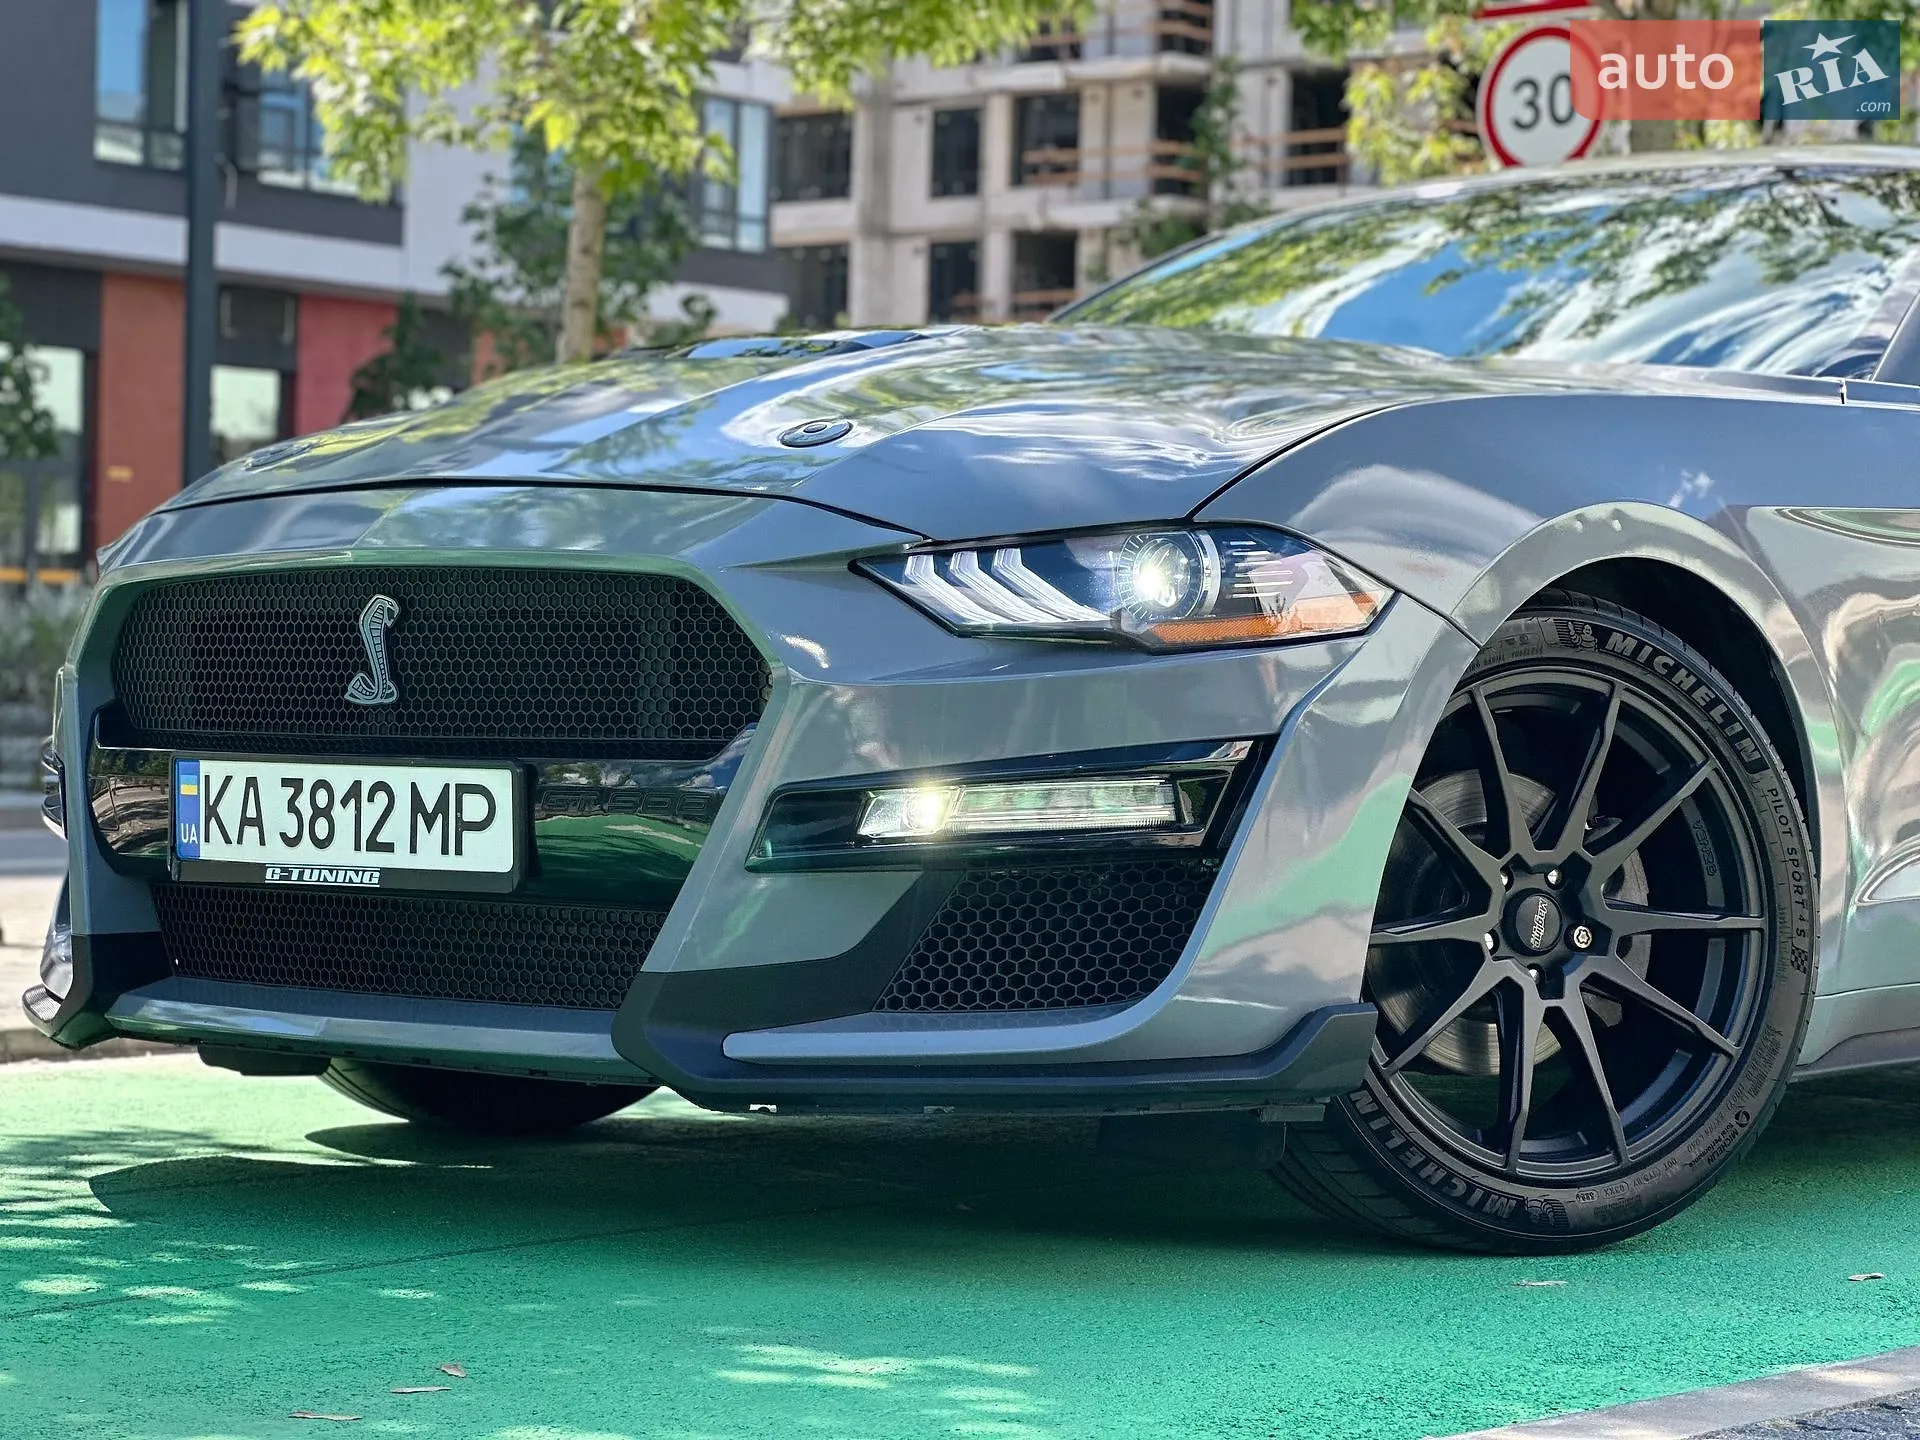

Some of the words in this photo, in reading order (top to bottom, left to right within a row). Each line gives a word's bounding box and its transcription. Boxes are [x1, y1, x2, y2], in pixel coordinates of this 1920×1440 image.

[1511, 73, 1576, 132] 30
[1605, 631, 1762, 763] MICHELIN
[181, 823, 198, 844] UA
[204, 774, 266, 847] KA
[280, 777, 395, 854] 3812
[409, 781, 497, 856] MP
[1767, 787, 1793, 837] PILOT
[265, 866, 380, 886] G-TUNING
[1787, 846, 1809, 909] SPORT
[1796, 927, 1806, 938] S
[1350, 1089, 1517, 1219] MICHELIN
[1707, 1128, 1739, 1165] MICHELIN
